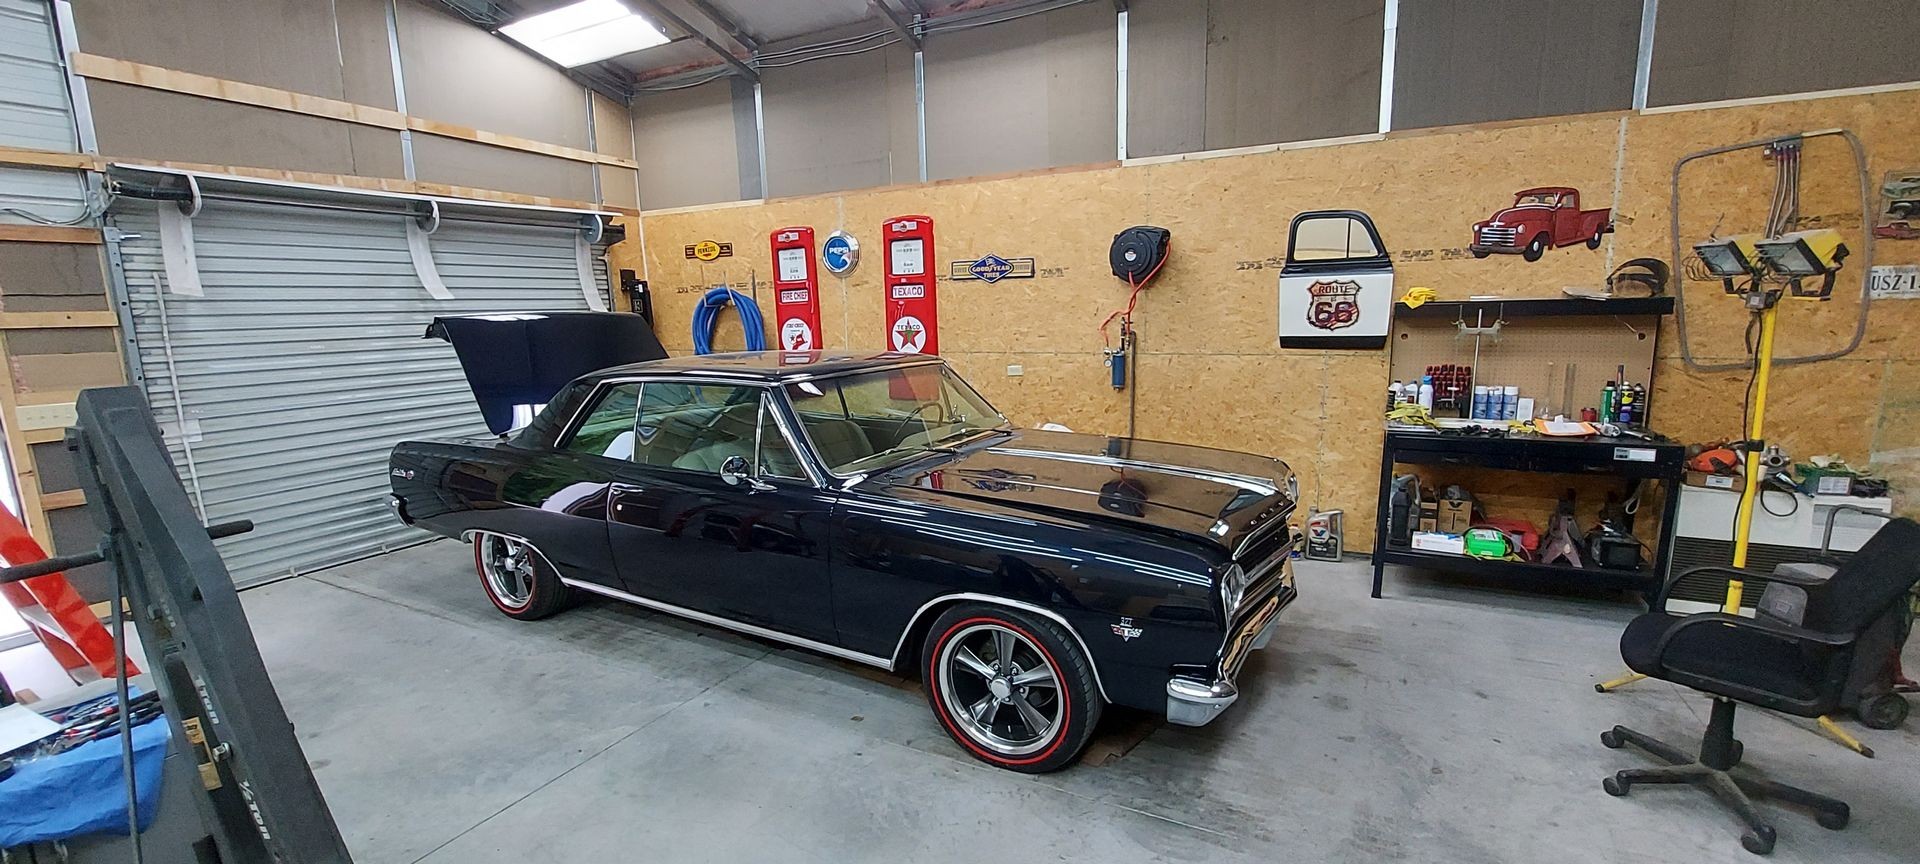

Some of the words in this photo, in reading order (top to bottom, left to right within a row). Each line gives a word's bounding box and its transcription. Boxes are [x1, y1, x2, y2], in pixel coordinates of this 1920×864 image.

[829, 246, 849, 255] PEPSI
[1870, 274, 1920, 292] USZ-1
[893, 286, 923, 297] TEXACO
[1318, 285, 1351, 294] ROUTE
[782, 292, 793, 301] FIRE
[794, 291, 808, 300] CHIEF
[1315, 301, 1354, 323] 66
[248, 800, 272, 840] Ton
